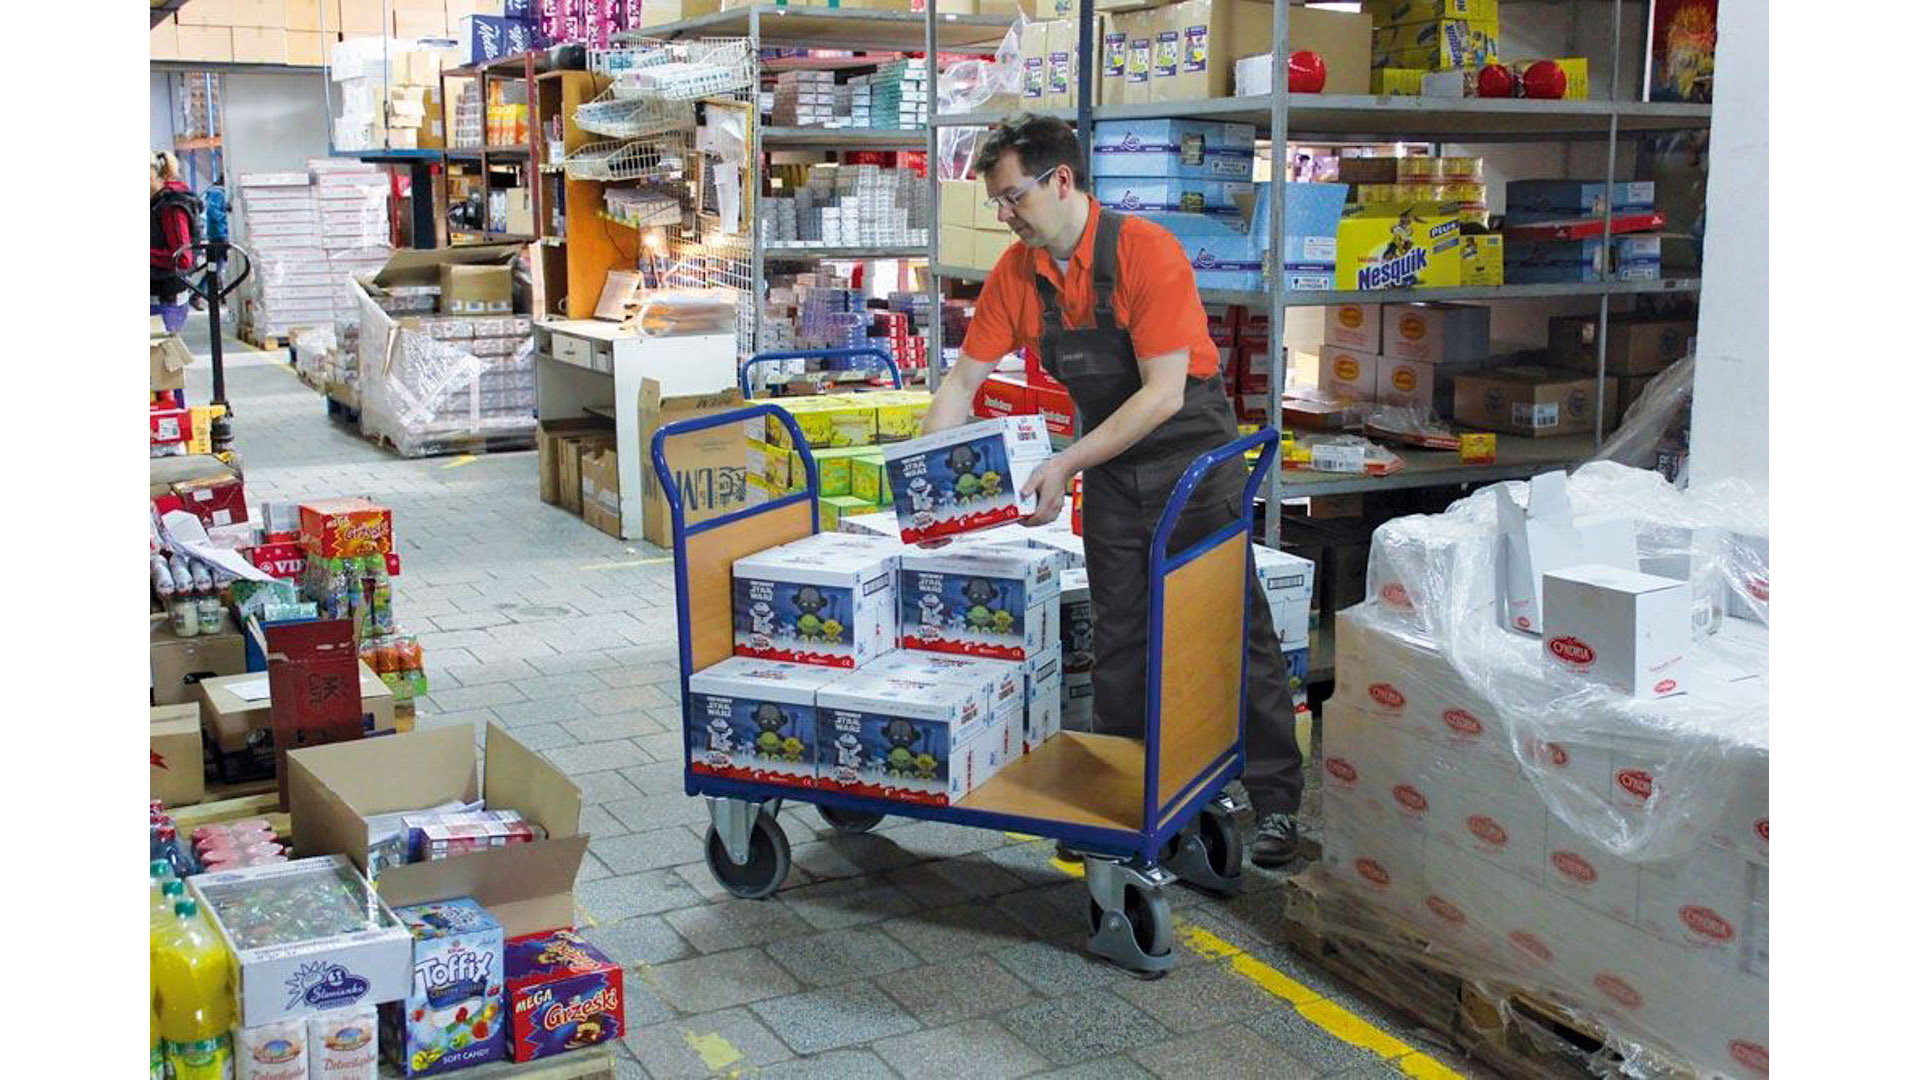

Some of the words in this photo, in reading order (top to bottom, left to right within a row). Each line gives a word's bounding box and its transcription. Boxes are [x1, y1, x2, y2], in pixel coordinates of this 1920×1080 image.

[1358, 247, 1427, 290] Nesquik
[415, 951, 493, 988] Toffix
[516, 988, 552, 1012] MEGA
